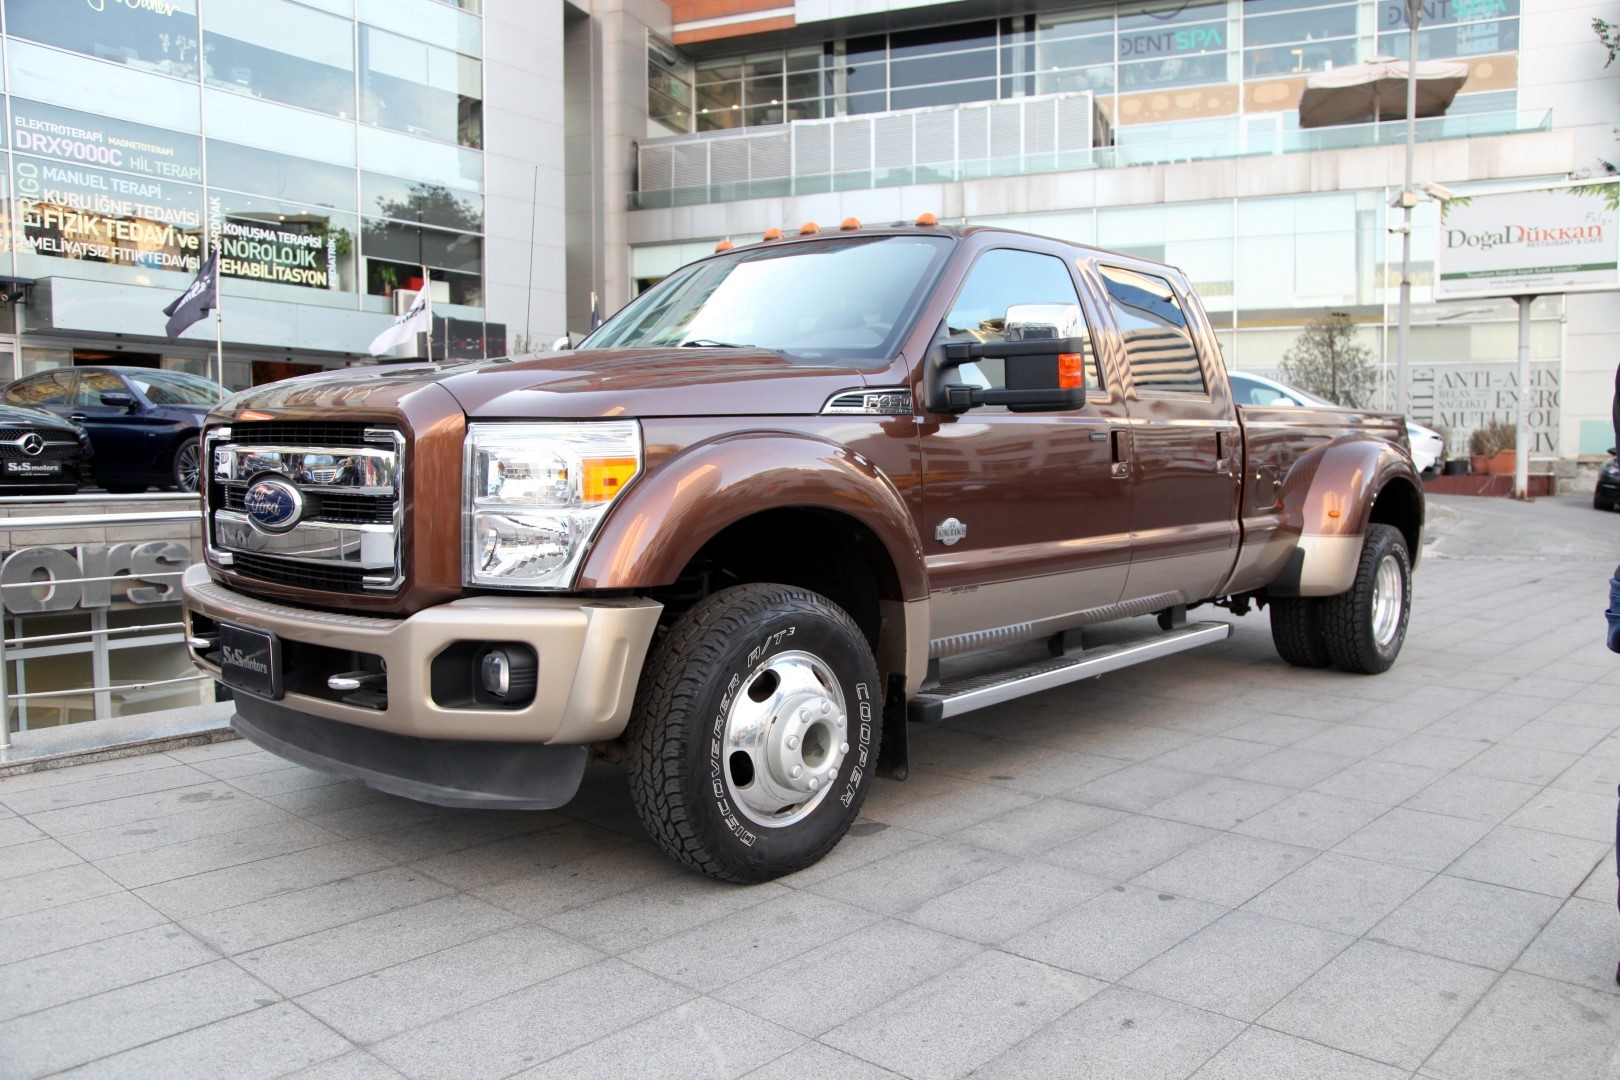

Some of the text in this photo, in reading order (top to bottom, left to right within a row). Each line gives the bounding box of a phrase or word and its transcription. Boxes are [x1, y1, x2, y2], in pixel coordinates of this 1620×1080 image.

[1388, 0, 1507, 26] DNTSPA
[1121, 27, 1222, 56] DENTSPA
[15, 115, 103, 142] ELEKTROTERAPİ
[16, 129, 122, 166] DRX9000C
[42, 166, 161, 199] MANUEL TERAPİ
[130, 156, 201, 181] HİL TERAPİ
[43, 188, 200, 226] KURU İĞNE TEDAVİSİ
[43, 208, 199, 249] FİZİK TEDAVİ ve
[223, 223, 322, 249] KONUŞMA TERAPİSİ
[20, 234, 110, 259] AMELİYATSIZ
[147, 252, 201, 269] TEDAVİSİ
[223, 237, 318, 268] NÖROLOJİK
[219, 258, 328, 286] EHABİLİTASYON
[250, 487, 281, 516] Ford
[243, 658, 268, 674] motors
[710, 672, 756, 847] DISCOVERER
[839, 682, 872, 808] COOPER
